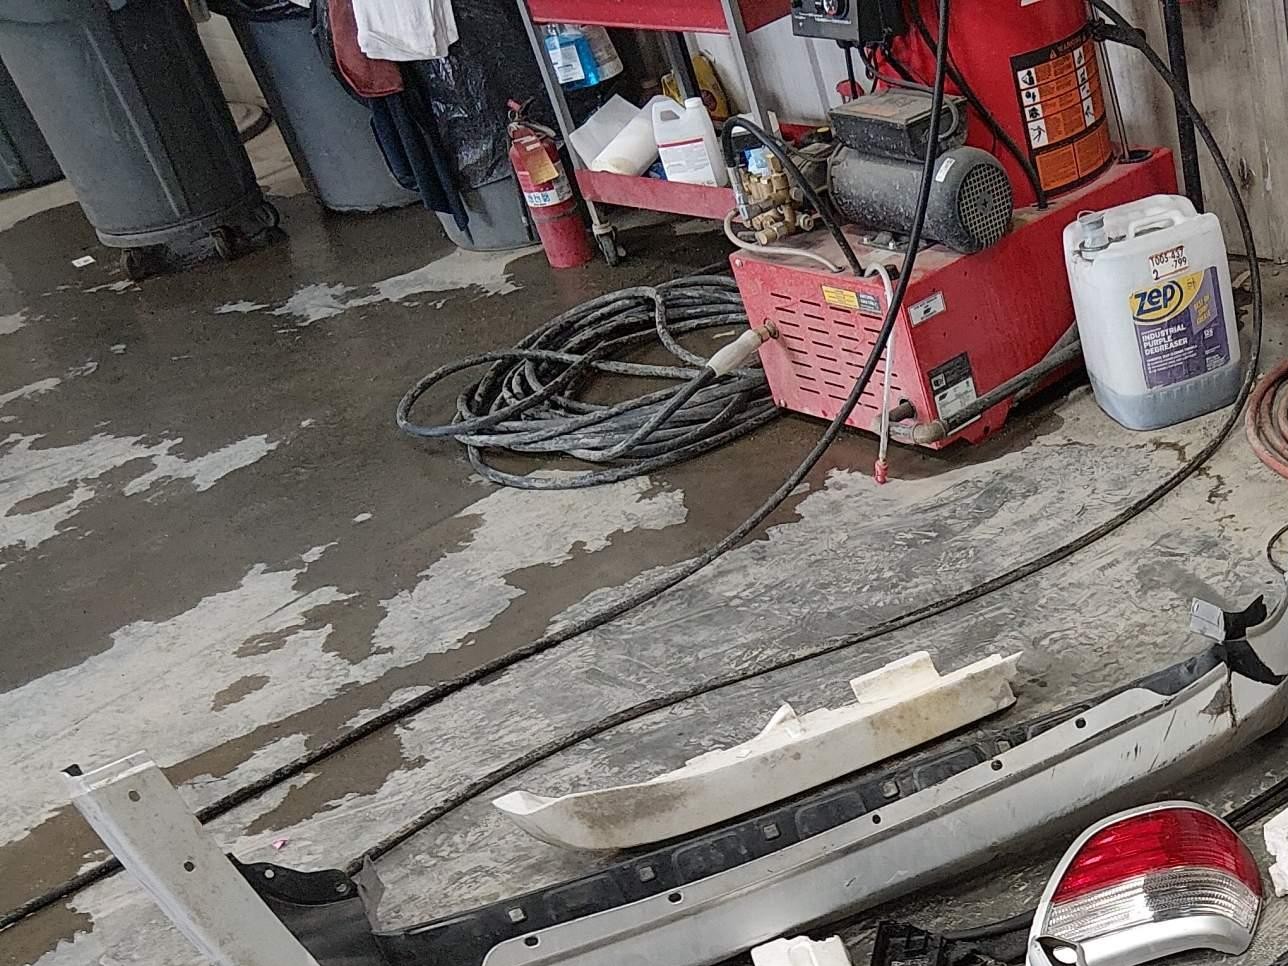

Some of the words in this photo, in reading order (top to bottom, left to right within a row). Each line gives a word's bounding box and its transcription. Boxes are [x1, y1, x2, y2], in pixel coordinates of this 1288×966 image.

[1142, 323, 1187, 342] INDUSTRIAL
[1143, 335, 1173, 349] PURPLE
[1144, 337, 1188, 356] DEGREASER
